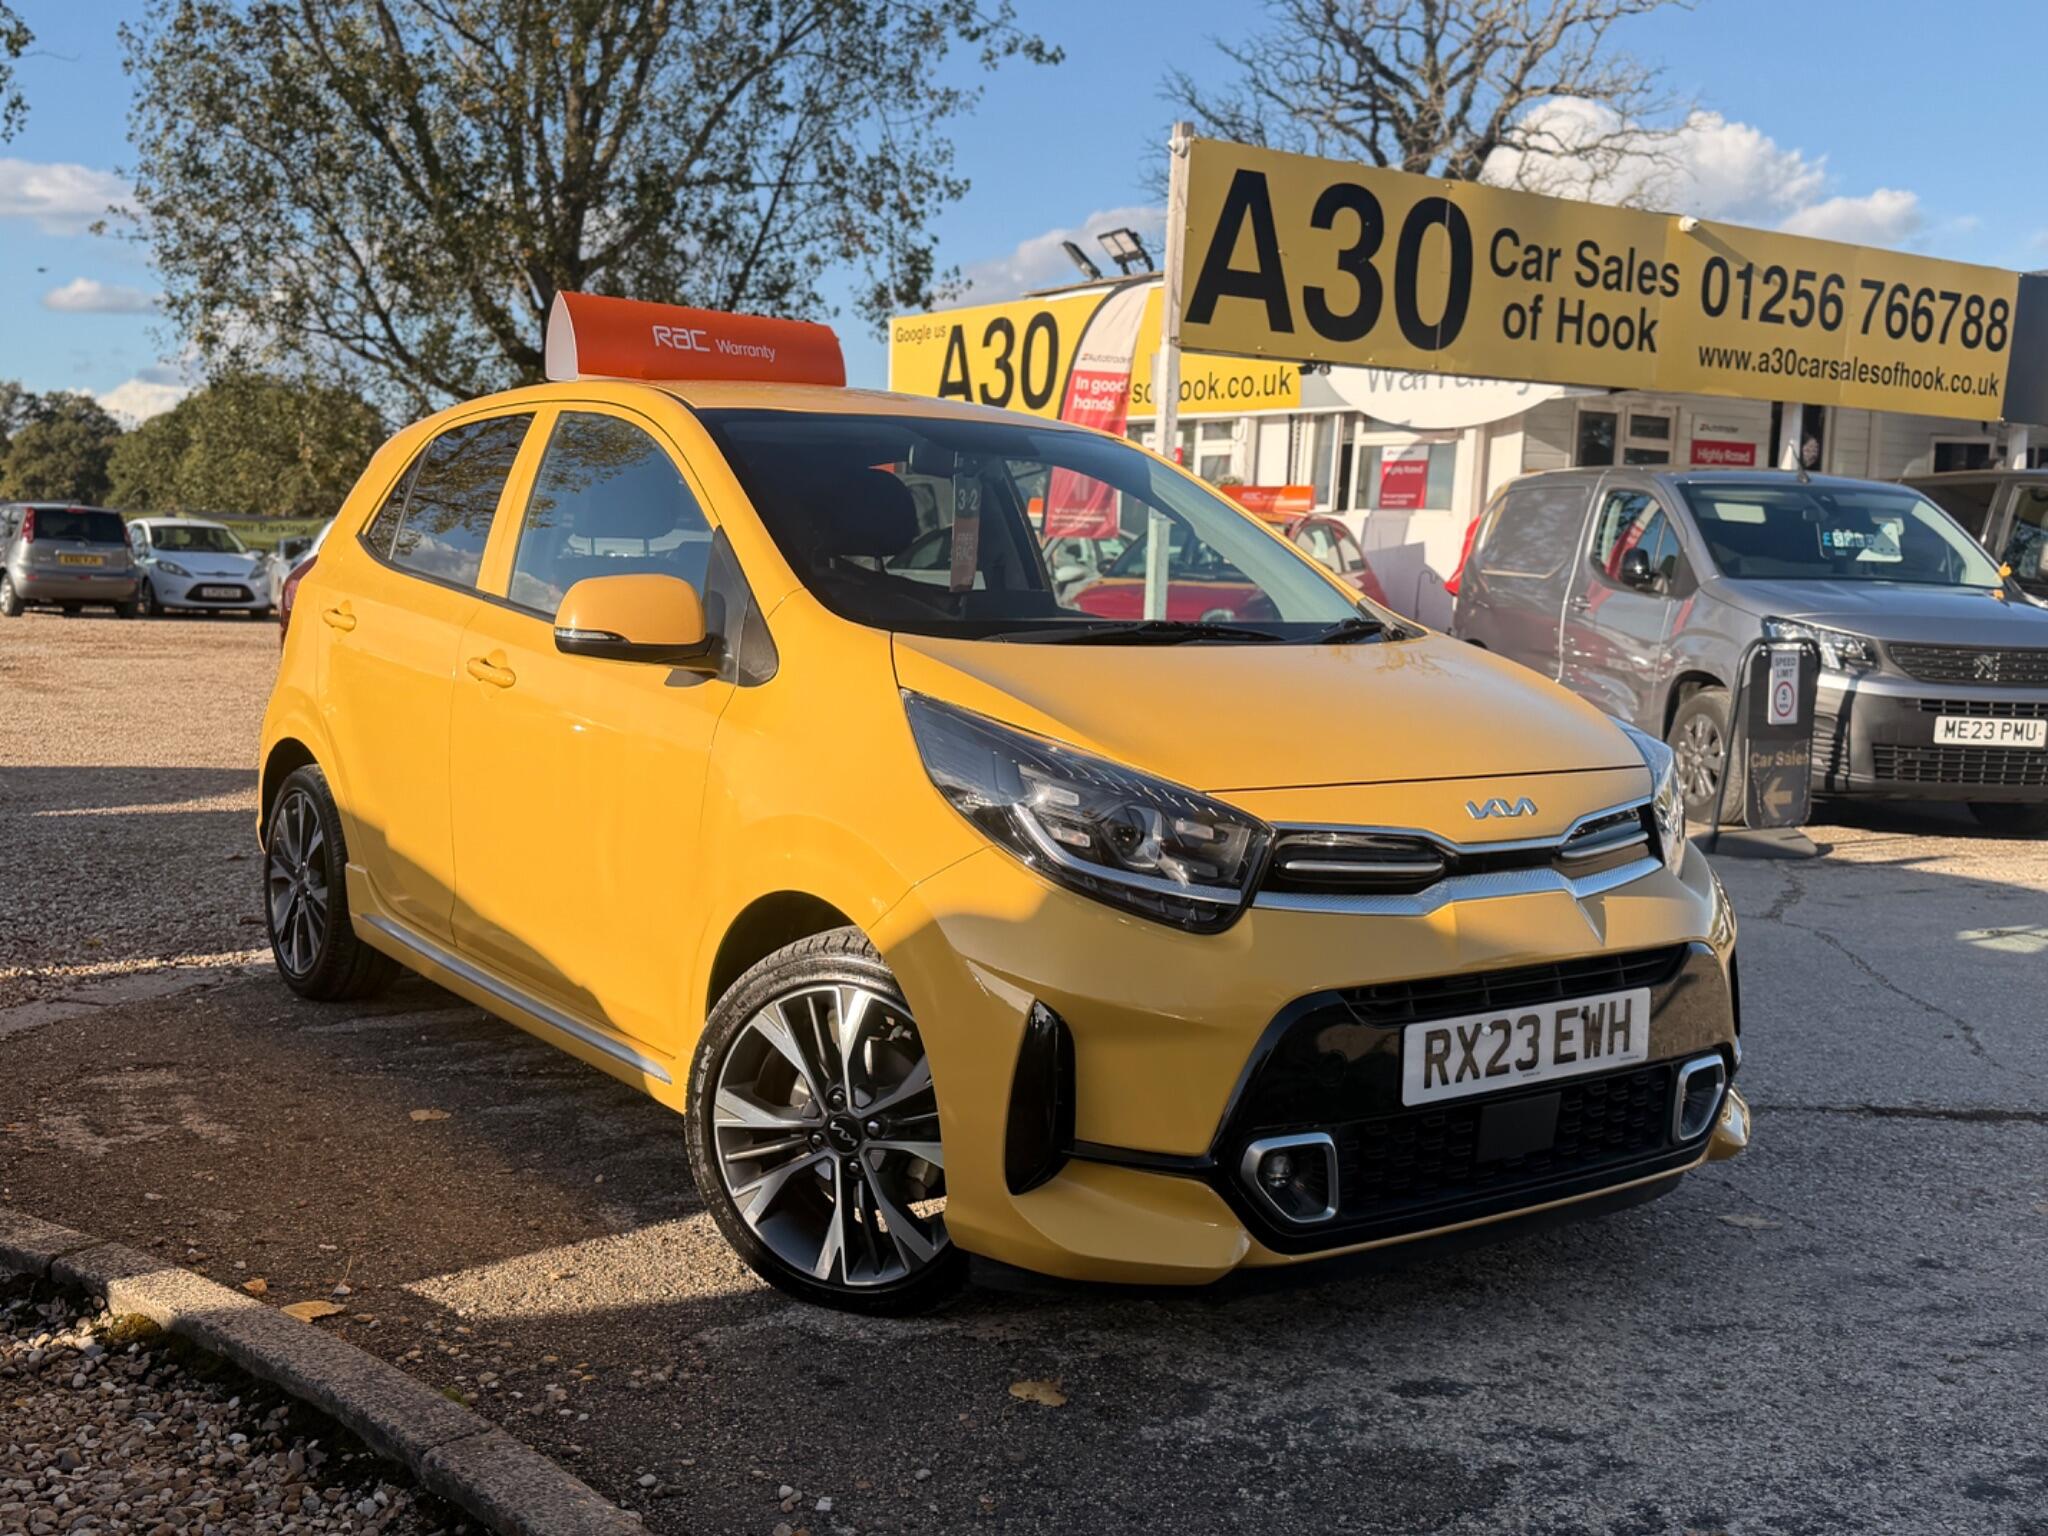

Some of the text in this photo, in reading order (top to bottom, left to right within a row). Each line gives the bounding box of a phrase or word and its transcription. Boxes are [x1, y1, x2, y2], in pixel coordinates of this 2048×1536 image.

[1185, 168, 1473, 352] A30
[1490, 228, 1680, 298] Car Sales
[1701, 256, 2010, 352] 01256 766788
[895, 324, 946, 345] Google us
[1502, 295, 1659, 353] of Hook
[715, 339, 776, 362] Warranty
[937, 311, 1060, 410] A30
[1698, 345, 2000, 397] www.a30carsalesofhook.co.uk
[1075, 376, 1128, 395] In good
[1073, 394, 1115, 412] hands
[1775, 657, 1796, 667] SPEED
[1776, 668, 1794, 678] LIMIT
[1781, 688, 1788, 701] 5
[1944, 719, 2038, 741] ME23 PMU
[1751, 750, 1809, 768] Car Sales
[1424, 998, 1632, 1090] RX23 EWH
